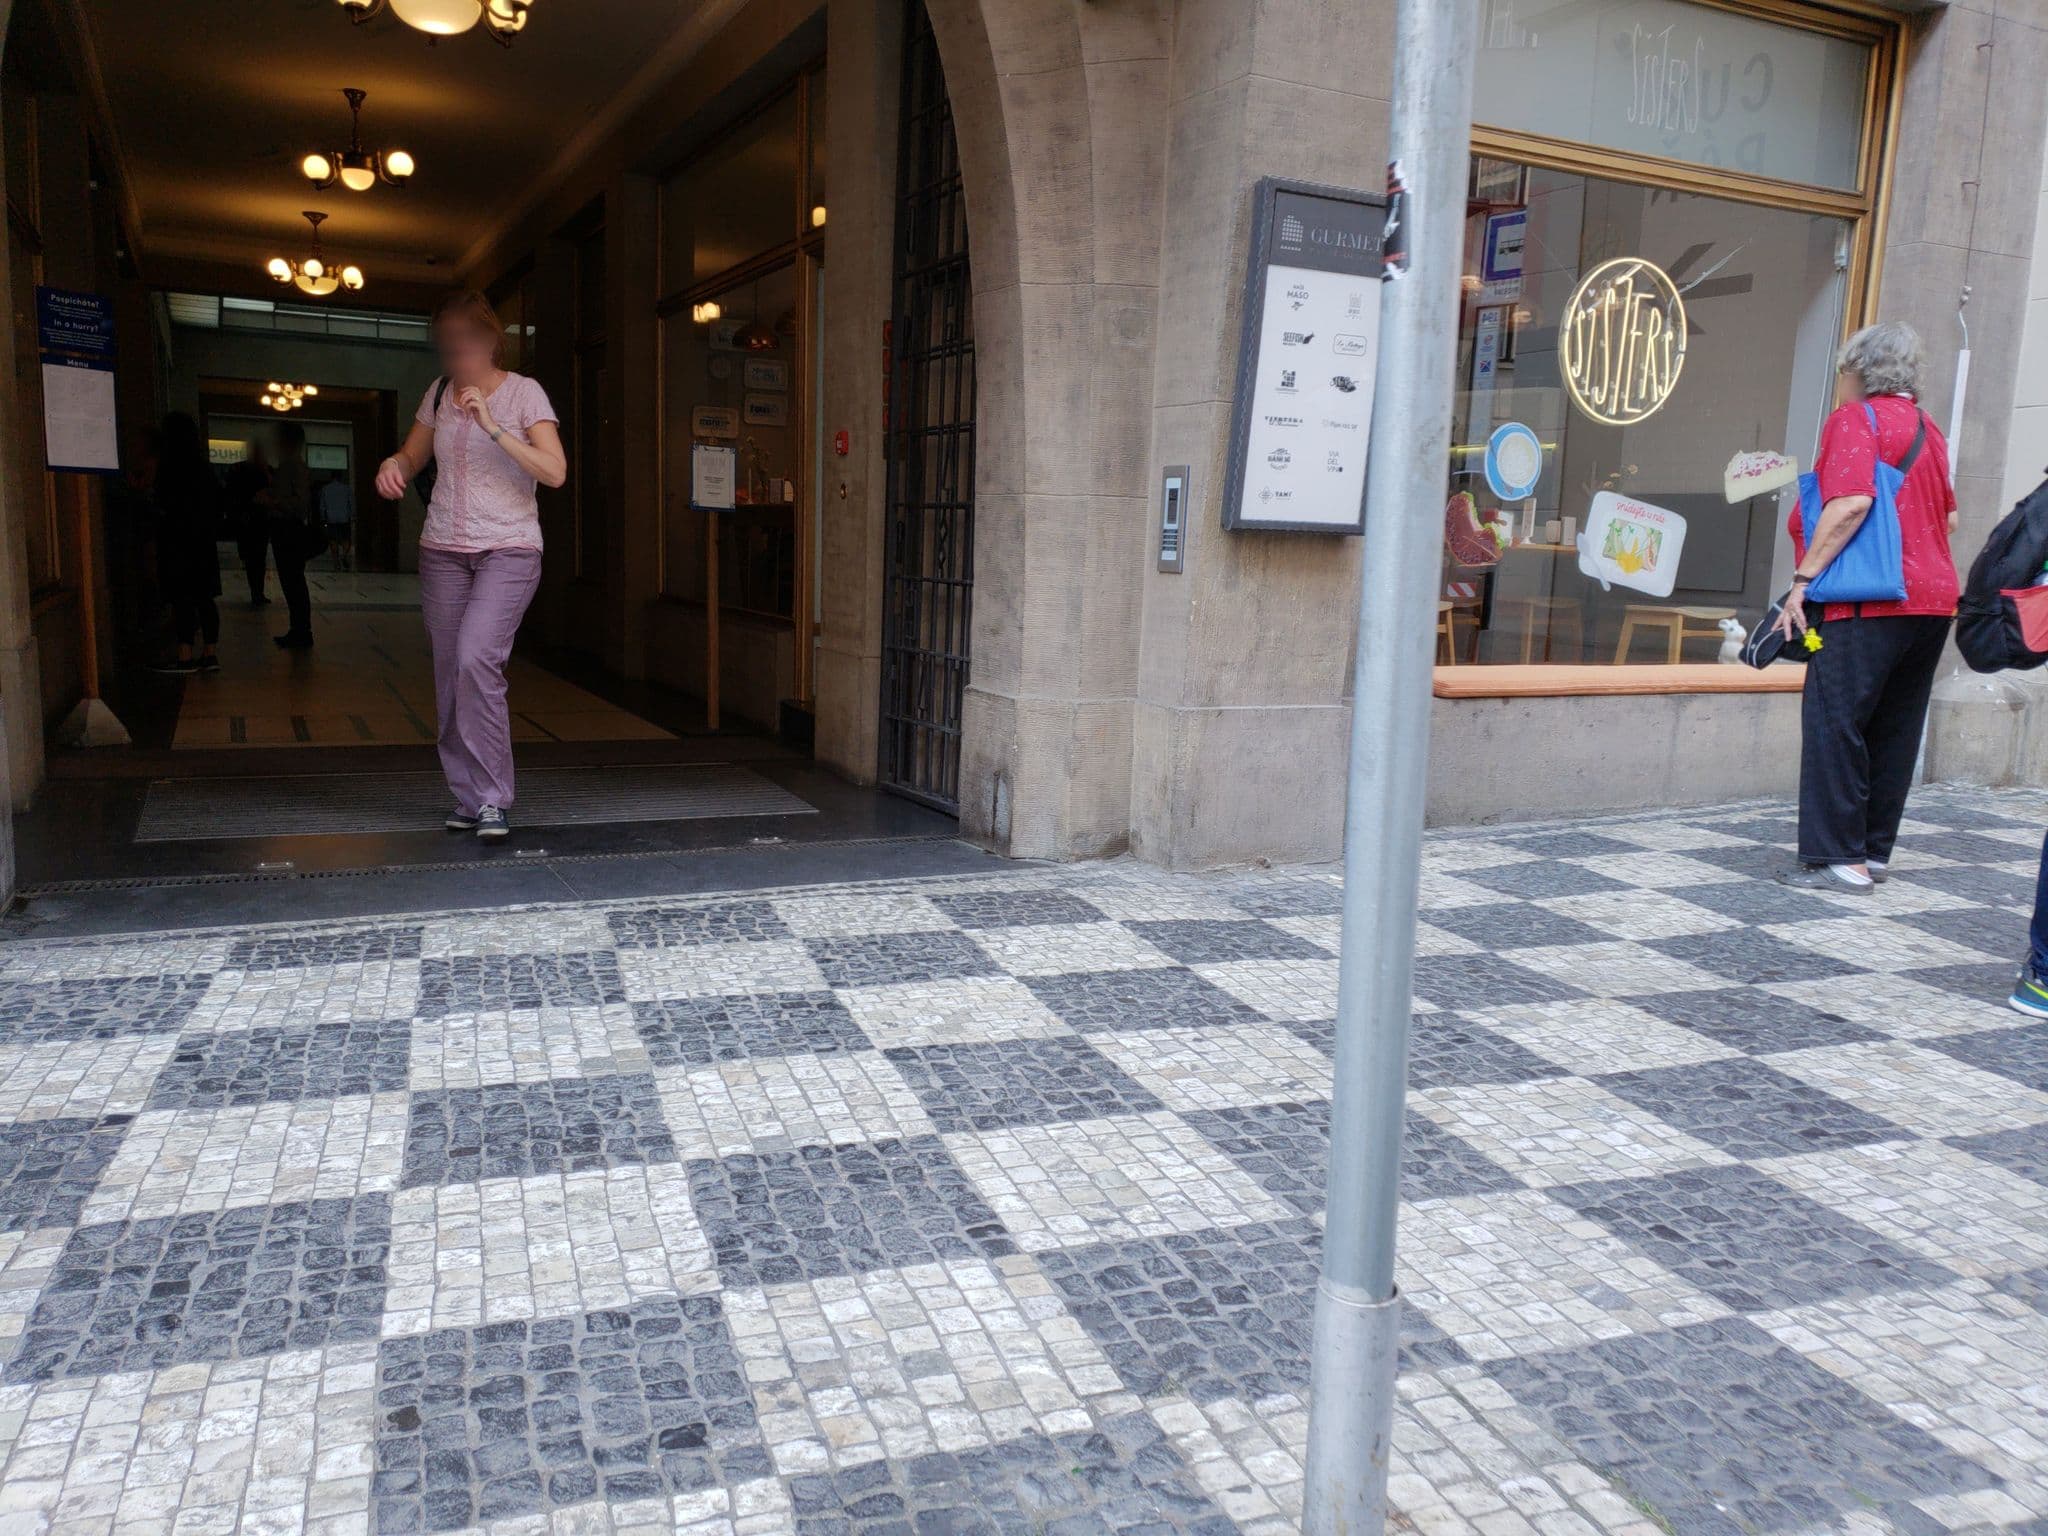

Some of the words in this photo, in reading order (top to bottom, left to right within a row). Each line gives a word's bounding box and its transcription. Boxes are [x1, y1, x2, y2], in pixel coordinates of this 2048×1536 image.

[1626, 22, 1704, 134] SISTERS
[1287, 290, 1309, 300] MASO
[1570, 266, 1674, 414] SISTERS
